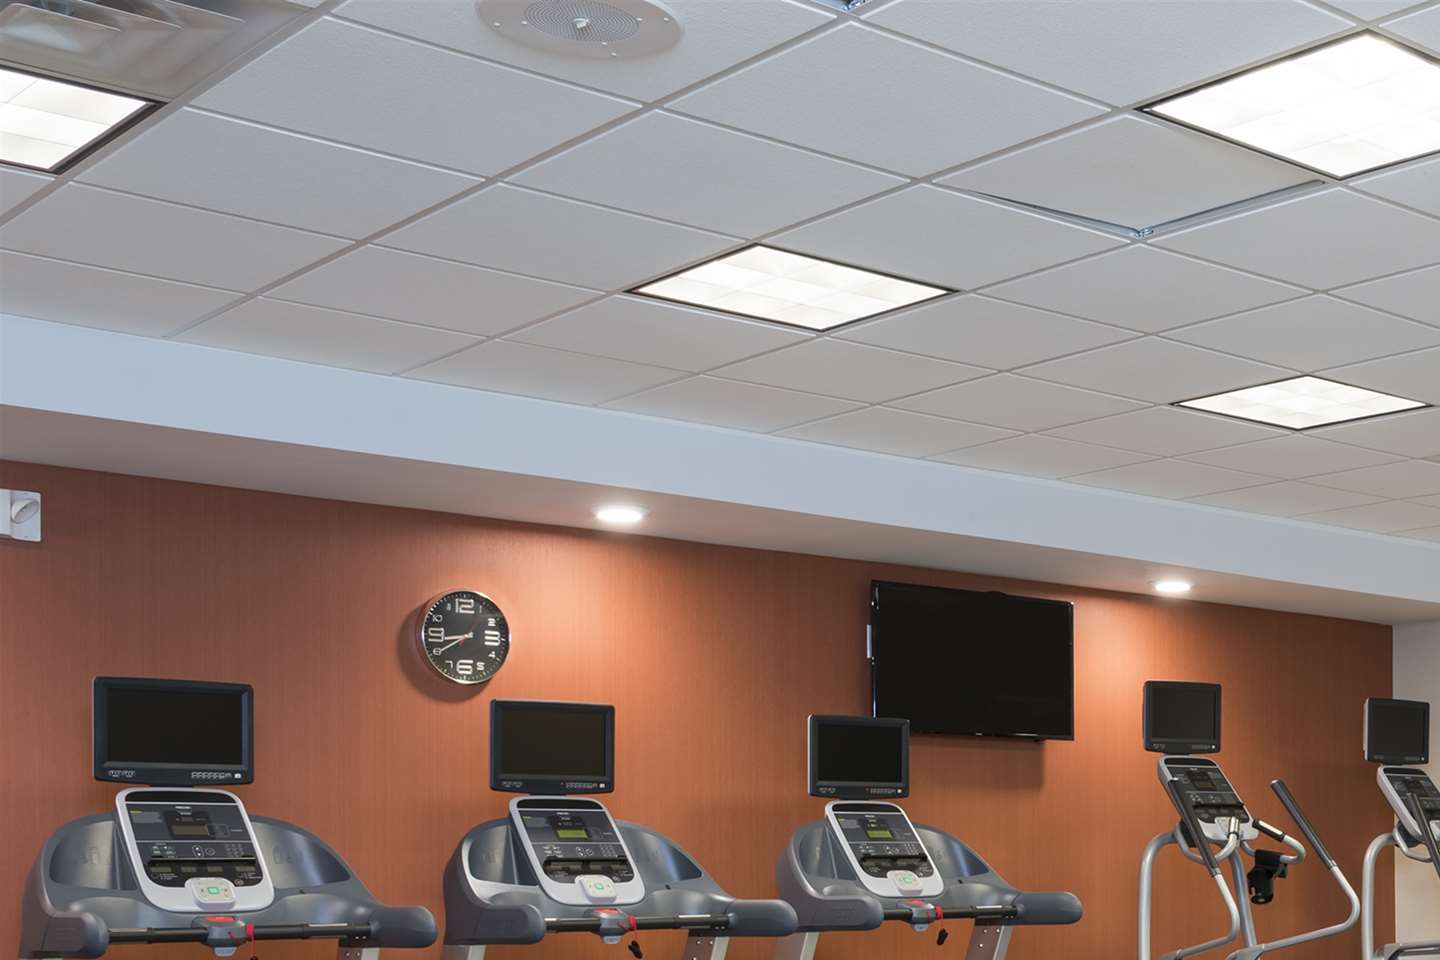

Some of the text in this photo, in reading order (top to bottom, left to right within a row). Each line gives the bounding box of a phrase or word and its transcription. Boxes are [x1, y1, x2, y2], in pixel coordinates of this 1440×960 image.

[455, 598, 475, 614] 12
[427, 627, 445, 643] 9
[484, 629, 501, 646] 3
[456, 659, 474, 675] 6
